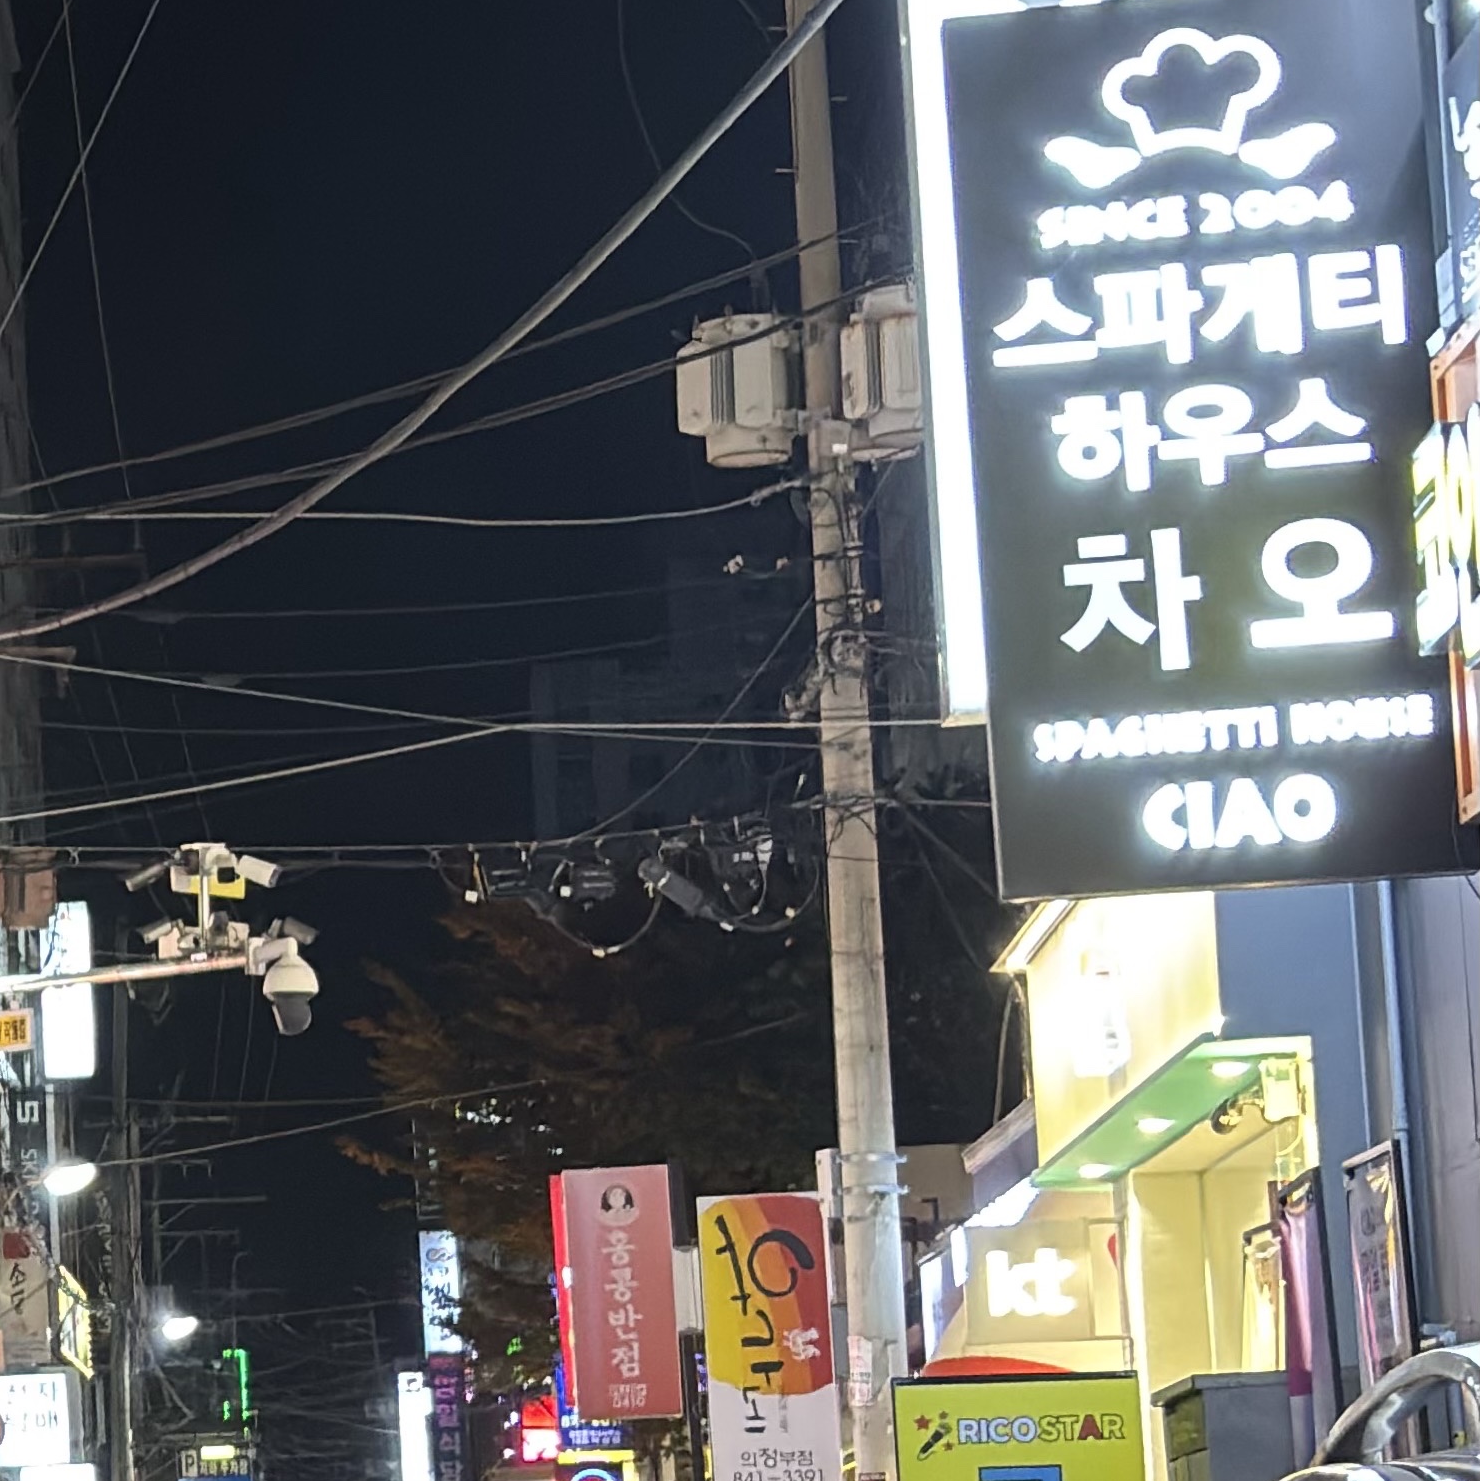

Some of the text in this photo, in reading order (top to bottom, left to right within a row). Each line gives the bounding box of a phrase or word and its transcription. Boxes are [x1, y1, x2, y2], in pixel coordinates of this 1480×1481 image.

[1036, 180, 1355, 251] SINCE 2004
[992, 242, 1409, 370] 스파게티
[1051, 378, 1375, 493] 하우스
[1033, 703, 1279, 764] SPAGHETTI
[1141, 772, 1338, 852] CIAO
[985, 1247, 1078, 1317] kt
[740, 1448, 814, 1468] 의정부점
[956, 1412, 1127, 1445] RICOSTAR
